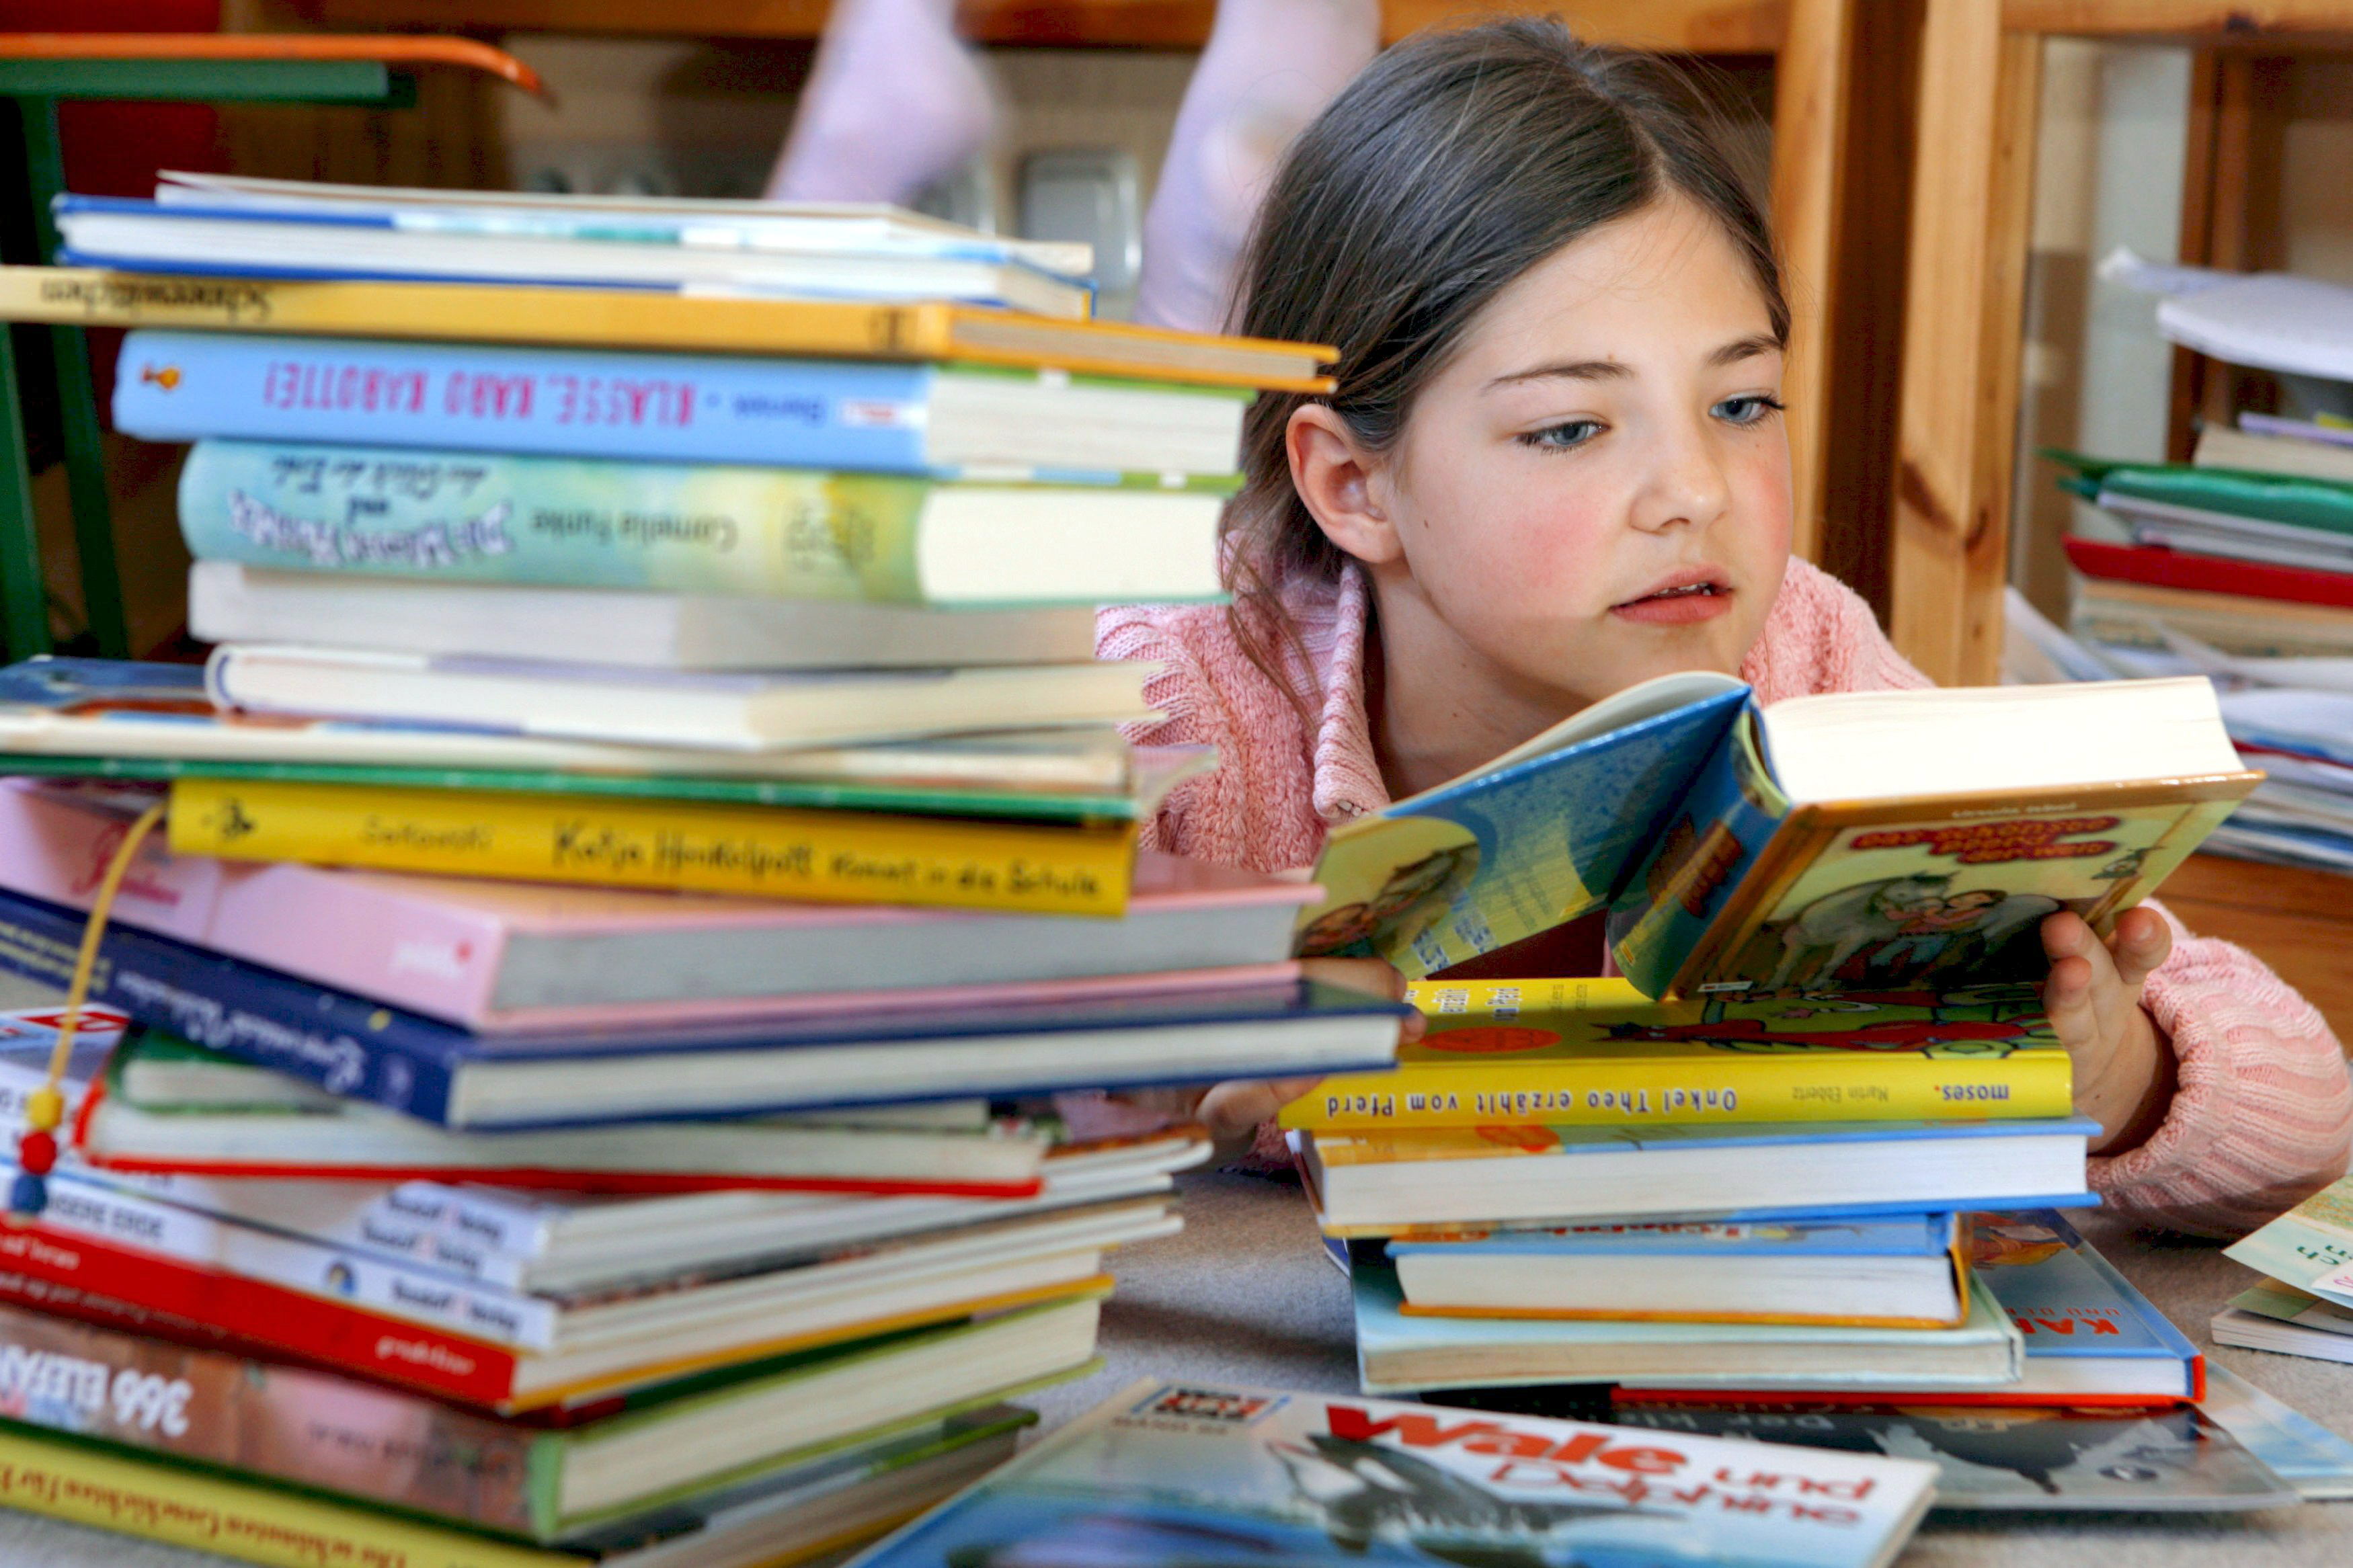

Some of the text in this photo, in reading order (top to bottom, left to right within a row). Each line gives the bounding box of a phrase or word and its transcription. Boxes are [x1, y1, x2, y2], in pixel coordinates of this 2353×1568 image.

[444, 370, 536, 419] KARO
[617, 509, 738, 554] Cornelia
[1327, 1087, 1737, 1118] Onkel Theo erzählt vom Pferd
[1845, 1085, 1889, 1102] Martin
[110, 1363, 194, 1438] 366
[1325, 1403, 1687, 1475] Wale
[1714, 1465, 1875, 1501] und
[1488, 1458, 1864, 1527] Delphine
